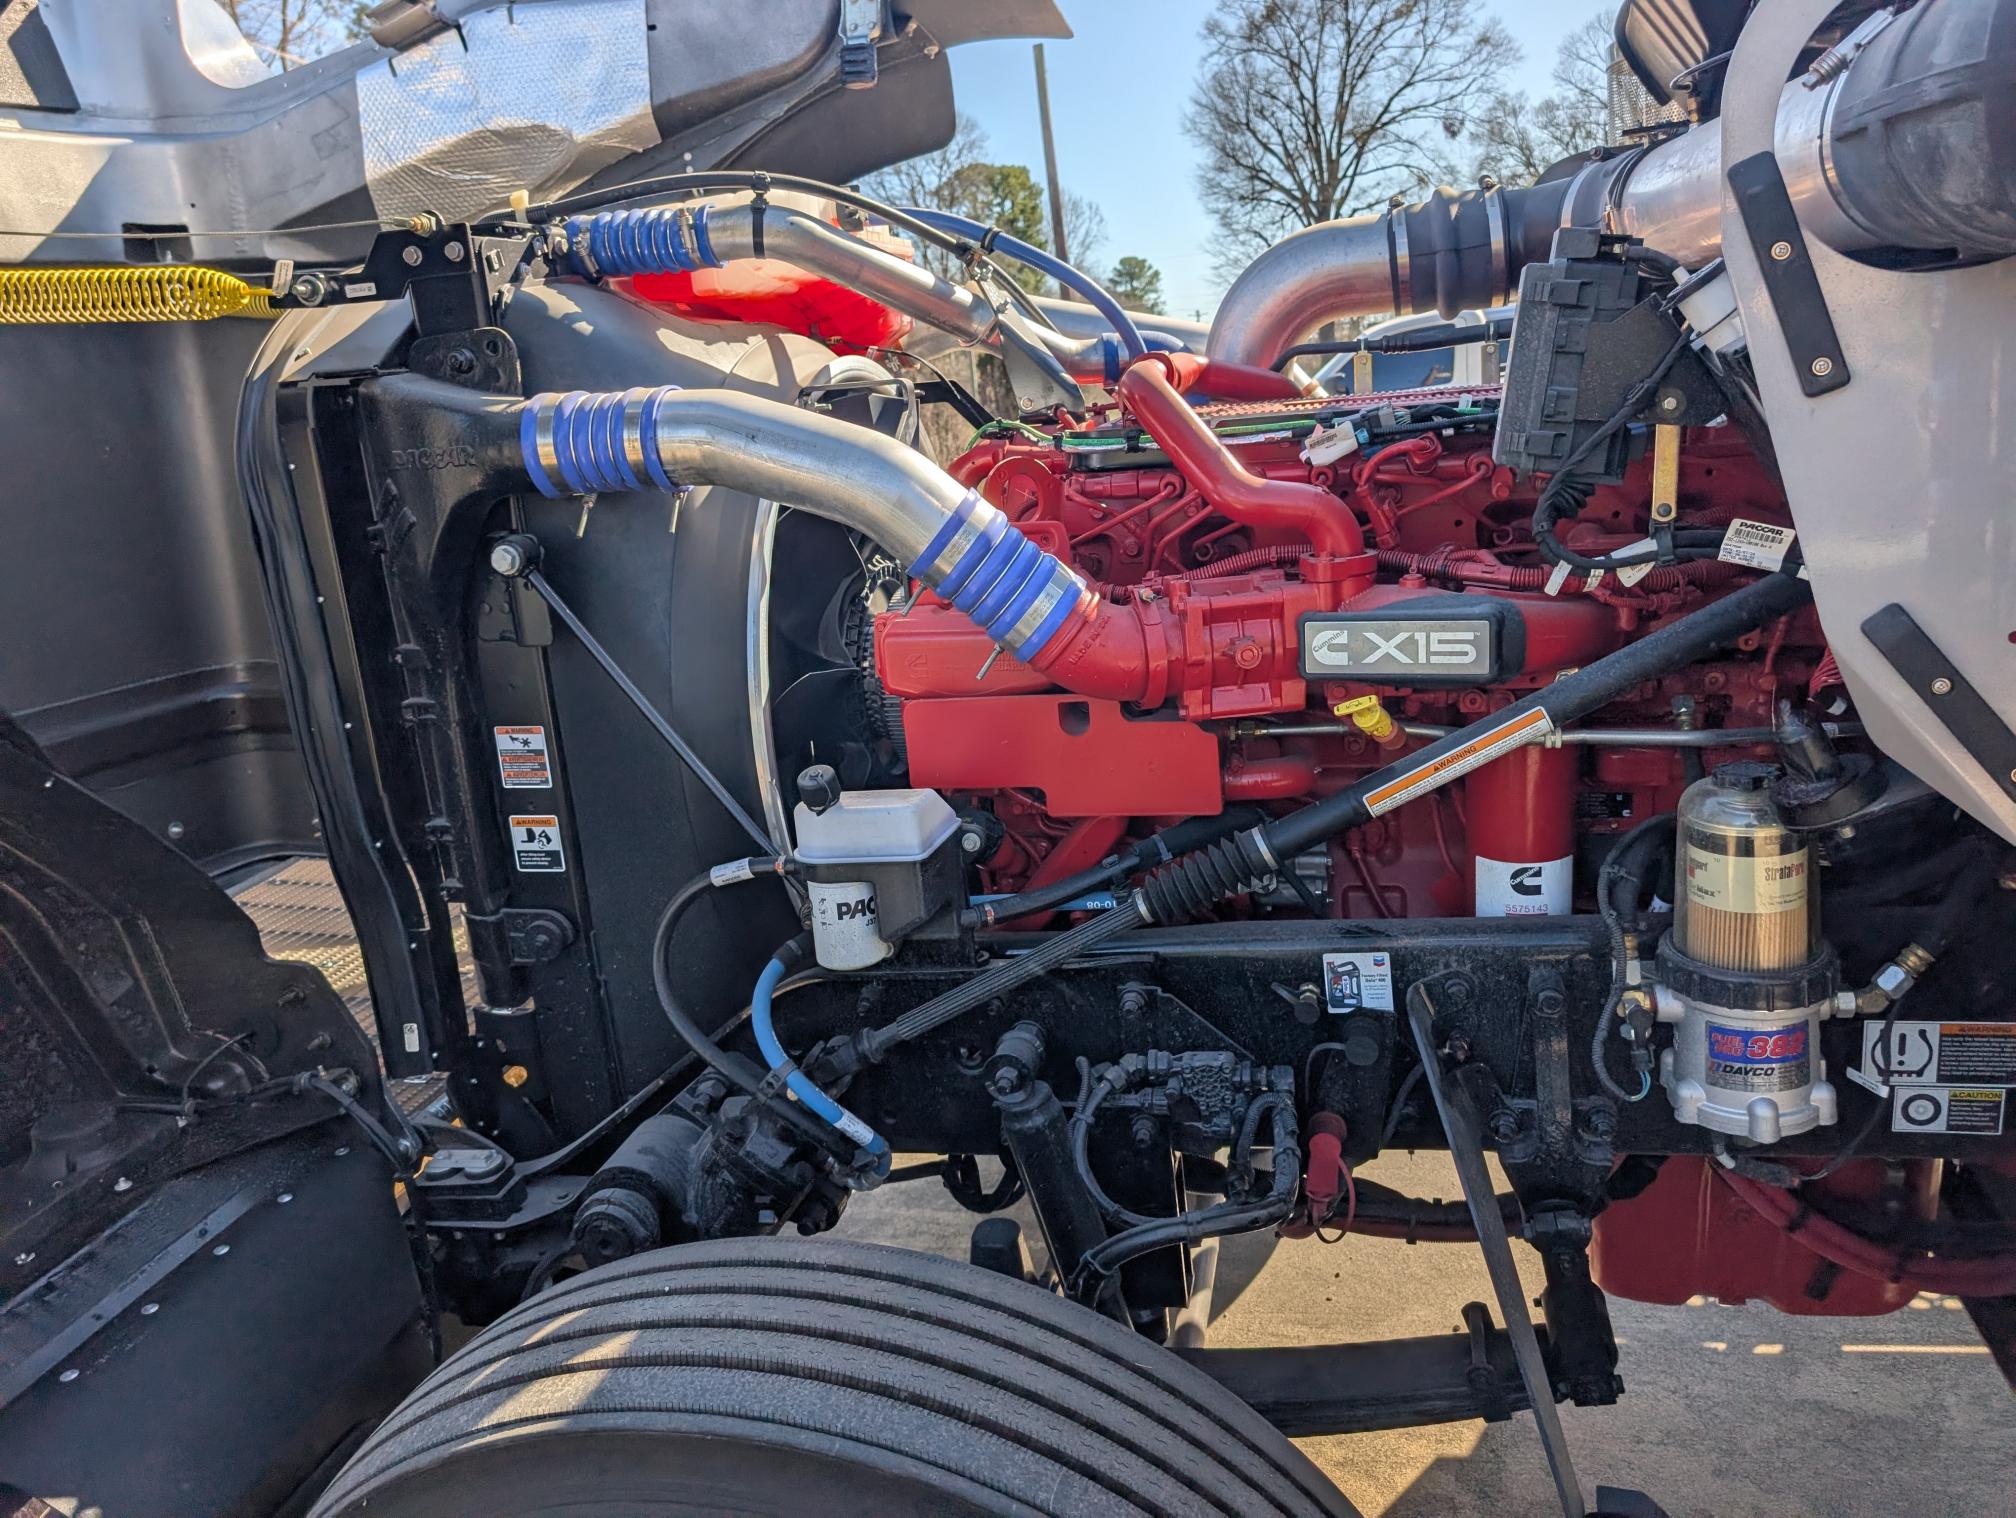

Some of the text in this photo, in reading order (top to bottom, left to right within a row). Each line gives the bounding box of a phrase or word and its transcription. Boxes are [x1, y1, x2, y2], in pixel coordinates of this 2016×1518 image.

[1740, 521, 1784, 536] PACCAR
[1313, 631, 1345, 653] Cummins
[1438, 745, 1477, 769] WARNING
[1510, 866, 1540, 886] Cummins
[1505, 904, 1549, 913] 5575143
[1722, 1064, 1775, 1076] DAVCO
[1957, 1091, 2001, 1099] CAUTION
